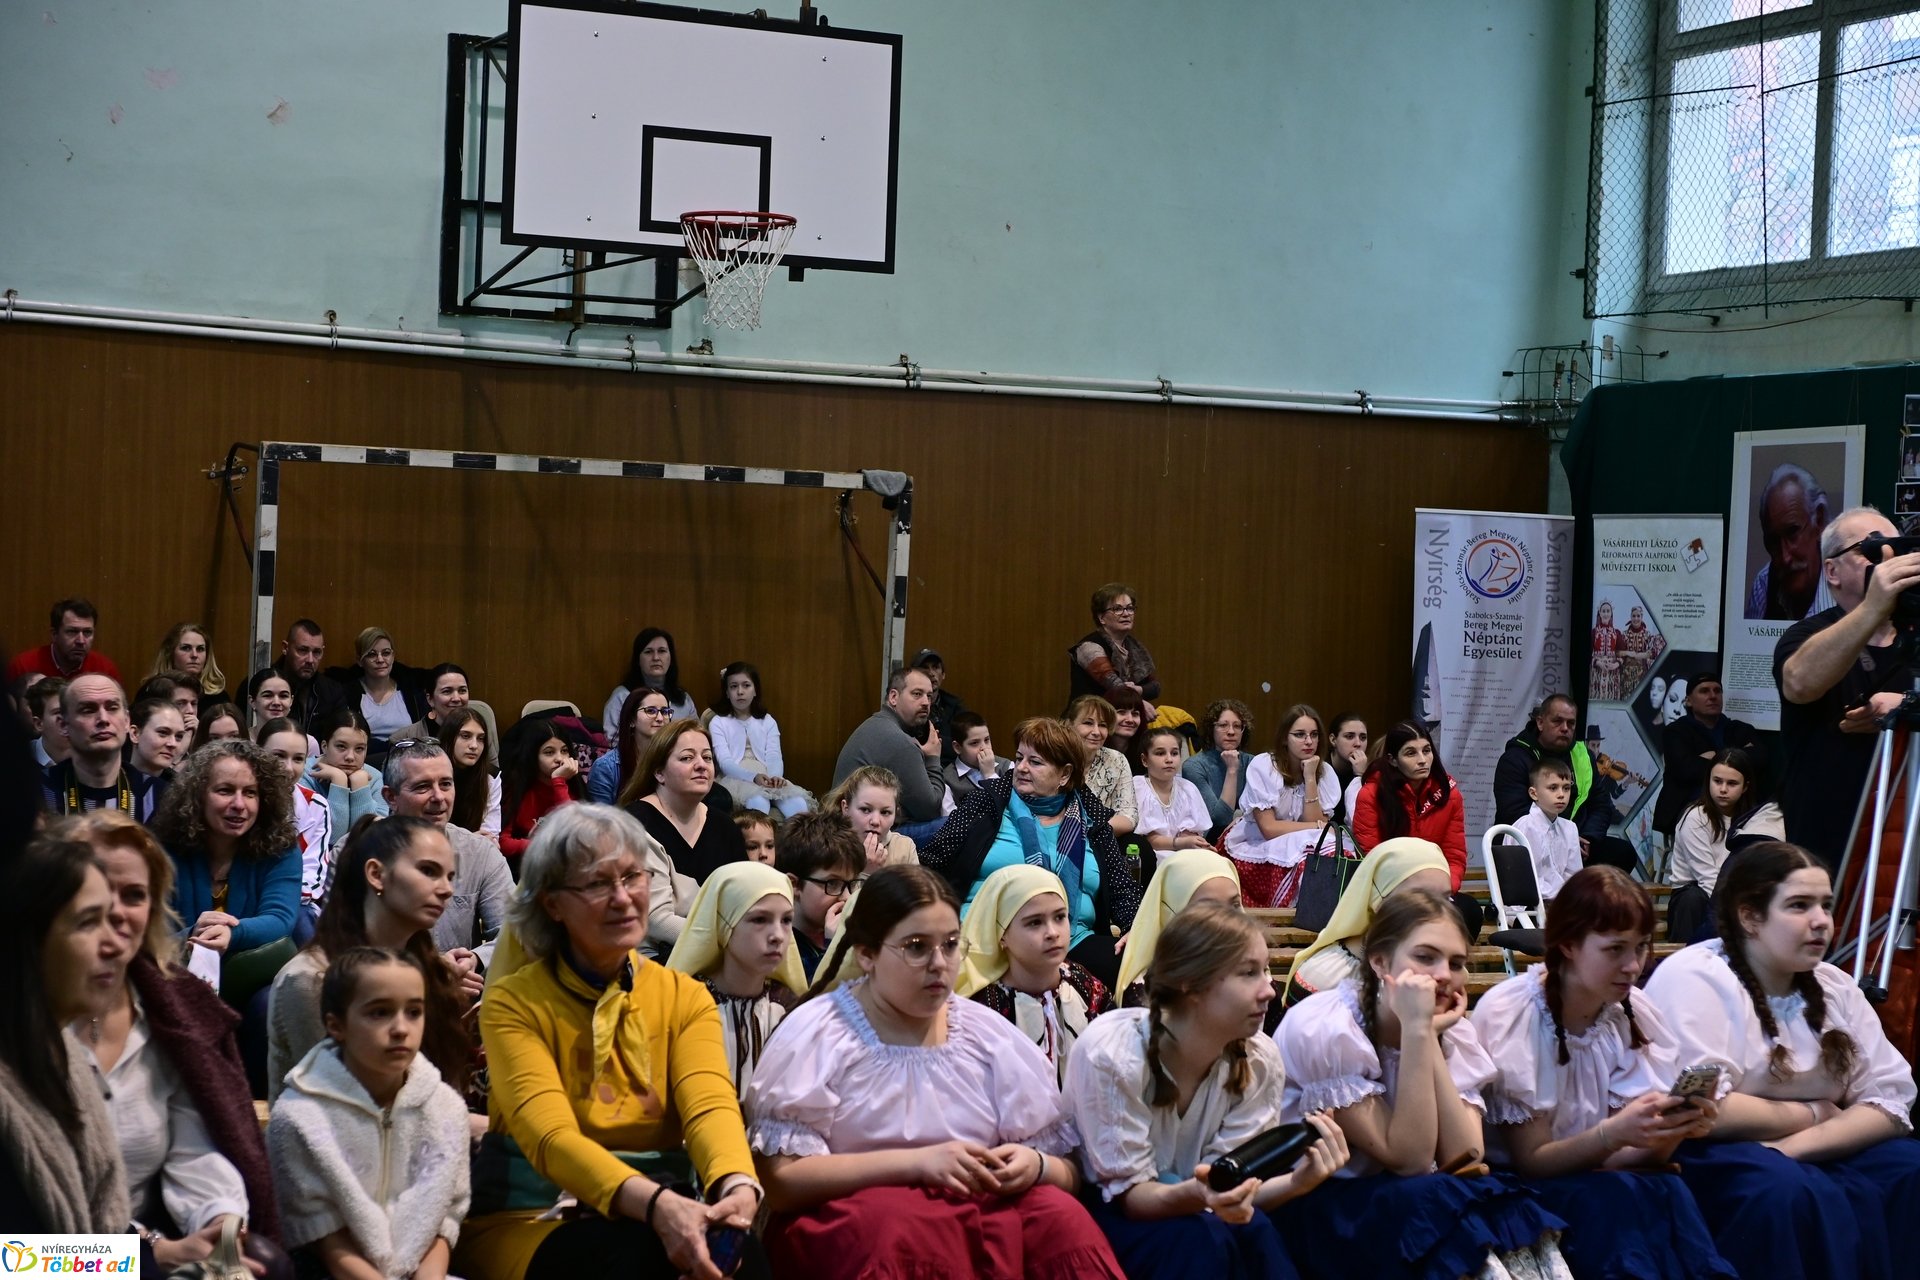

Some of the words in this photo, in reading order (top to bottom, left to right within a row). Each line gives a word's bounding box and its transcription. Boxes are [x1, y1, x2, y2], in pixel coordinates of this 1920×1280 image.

[1489, 529, 1519, 544] Megyei
[1517, 541, 1534, 574] Néptánc
[1423, 528, 1450, 609] Nyírség
[1545, 530, 1567, 616] Szatmár
[1507, 575, 1534, 605] Egyesület
[1463, 619, 1489, 631] Bereg
[1491, 621, 1523, 632] Megyei
[1464, 611, 1525, 621] Szabolcs-Szatmár-
[1463, 630, 1523, 646] Néptánc
[1463, 645, 1523, 660] Egyesület
[1542, 626, 1564, 696] Rétköz
[120, 789, 128, 810] Nikon
